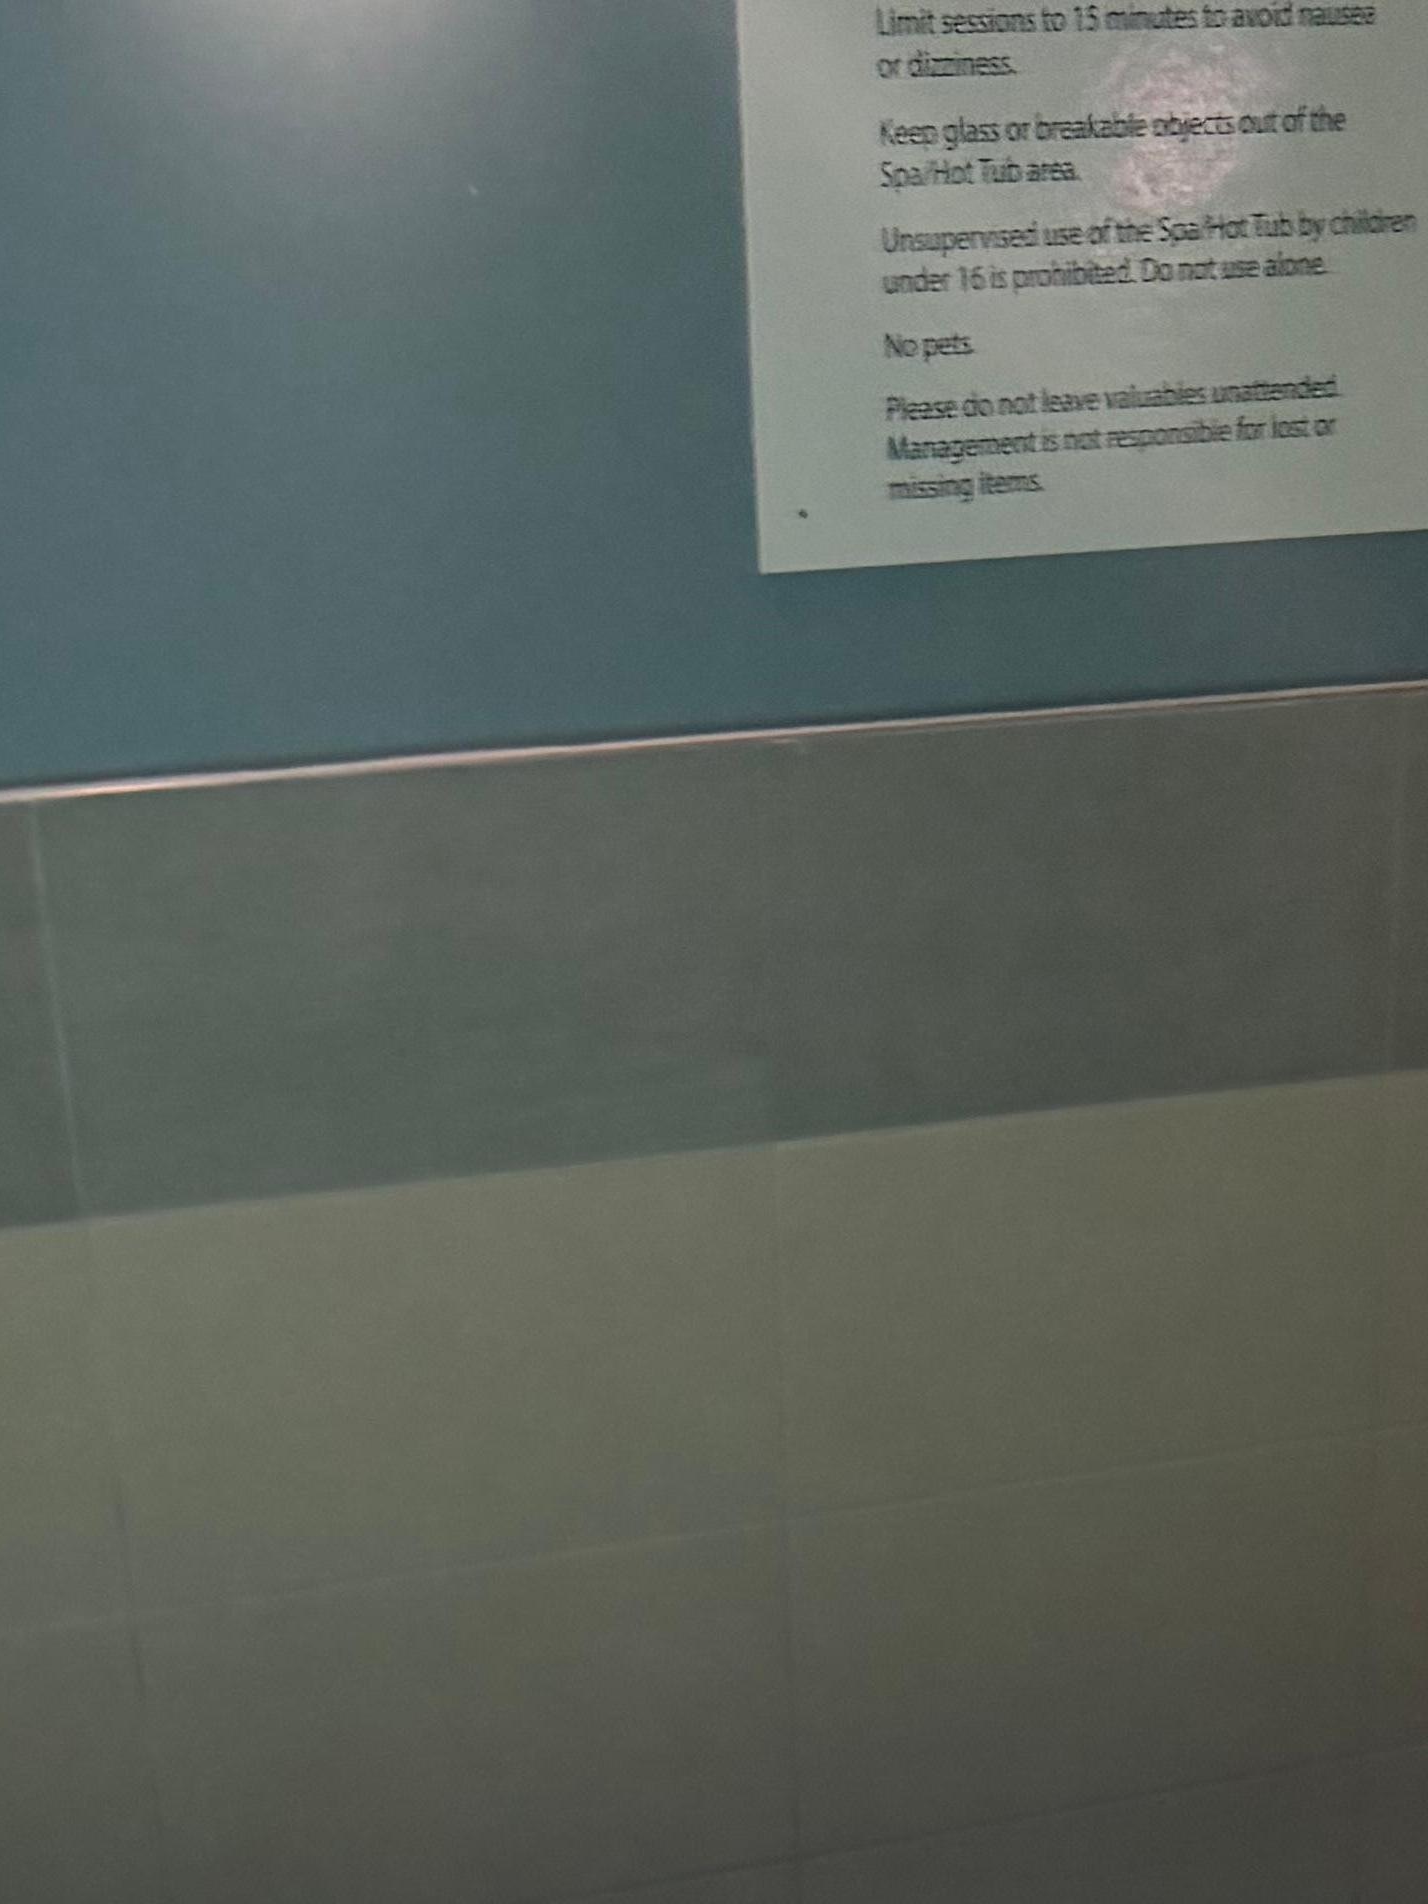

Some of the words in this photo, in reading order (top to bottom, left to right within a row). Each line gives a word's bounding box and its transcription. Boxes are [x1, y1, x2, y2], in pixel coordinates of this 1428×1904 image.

[876, 7, 935, 36] Limit
[941, 7, 1036, 34] sessions
[1041, 8, 1067, 33] to
[1074, 4, 1100, 32] 15
[1105, 2, 1198, 31] minutes
[1202, 5, 1226, 29] to
[1230, 2, 1294, 28] avoid
[1298, 6, 1376, 26] nausea
[876, 58, 902, 78] or
[907, 50, 1018, 78] dizziness.
[879, 118, 939, 150] Keep
[942, 115, 1000, 150] glass
[1005, 121, 1030, 142] or
[1034, 111, 1148, 141] breakable
[1152, 111, 1236, 143] objects
[1238, 111, 1276, 134] out
[1281, 105, 1308, 133] of
[1310, 103, 1348, 133] the
[880, 157, 974, 193] Spa/Hot
[977, 155, 1022, 184] Tub
[1025, 160, 1082, 183] area.
[881, 220, 1039, 257] Unsupervised
[1043, 225, 1083, 247] use
[1086, 216, 1115, 245] of
[1116, 215, 1154, 243] the
[1159, 213, 1249, 248] Spa/Hot
[1250, 210, 1296, 239] Tub
[1297, 208, 1327, 244] by
[1330, 207, 1418, 236] children
[882, 264, 952, 294] under
[958, 264, 987, 292] 16
[989, 263, 1008, 290] is
[1011, 255, 1138, 296] prohibited.
[1140, 256, 1174, 283] Do
[1177, 257, 1218, 281] not
[1221, 260, 1261, 280] use
[1264, 251, 1330, 278] alone.
[883, 332, 919, 358] No
[921, 332, 976, 364] pets.
[886, 396, 956, 421] Please
[962, 390, 995, 418] do
[999, 392, 1037, 416] not
[1040, 386, 1100, 414] leave
[1104, 382, 1207, 409] valuables
[1209, 373, 1341, 404] unattended.
[887, 434, 1037, 465] Management
[1041, 428, 1062, 453] is
[1063, 428, 1103, 450] not
[1104, 418, 1232, 454] responsible
[1235, 414, 1268, 441] for
[1271, 413, 1310, 439] lost
[1313, 417, 1338, 437] or
[887, 474, 974, 504] missing
[976, 470, 1046, 495] items.
